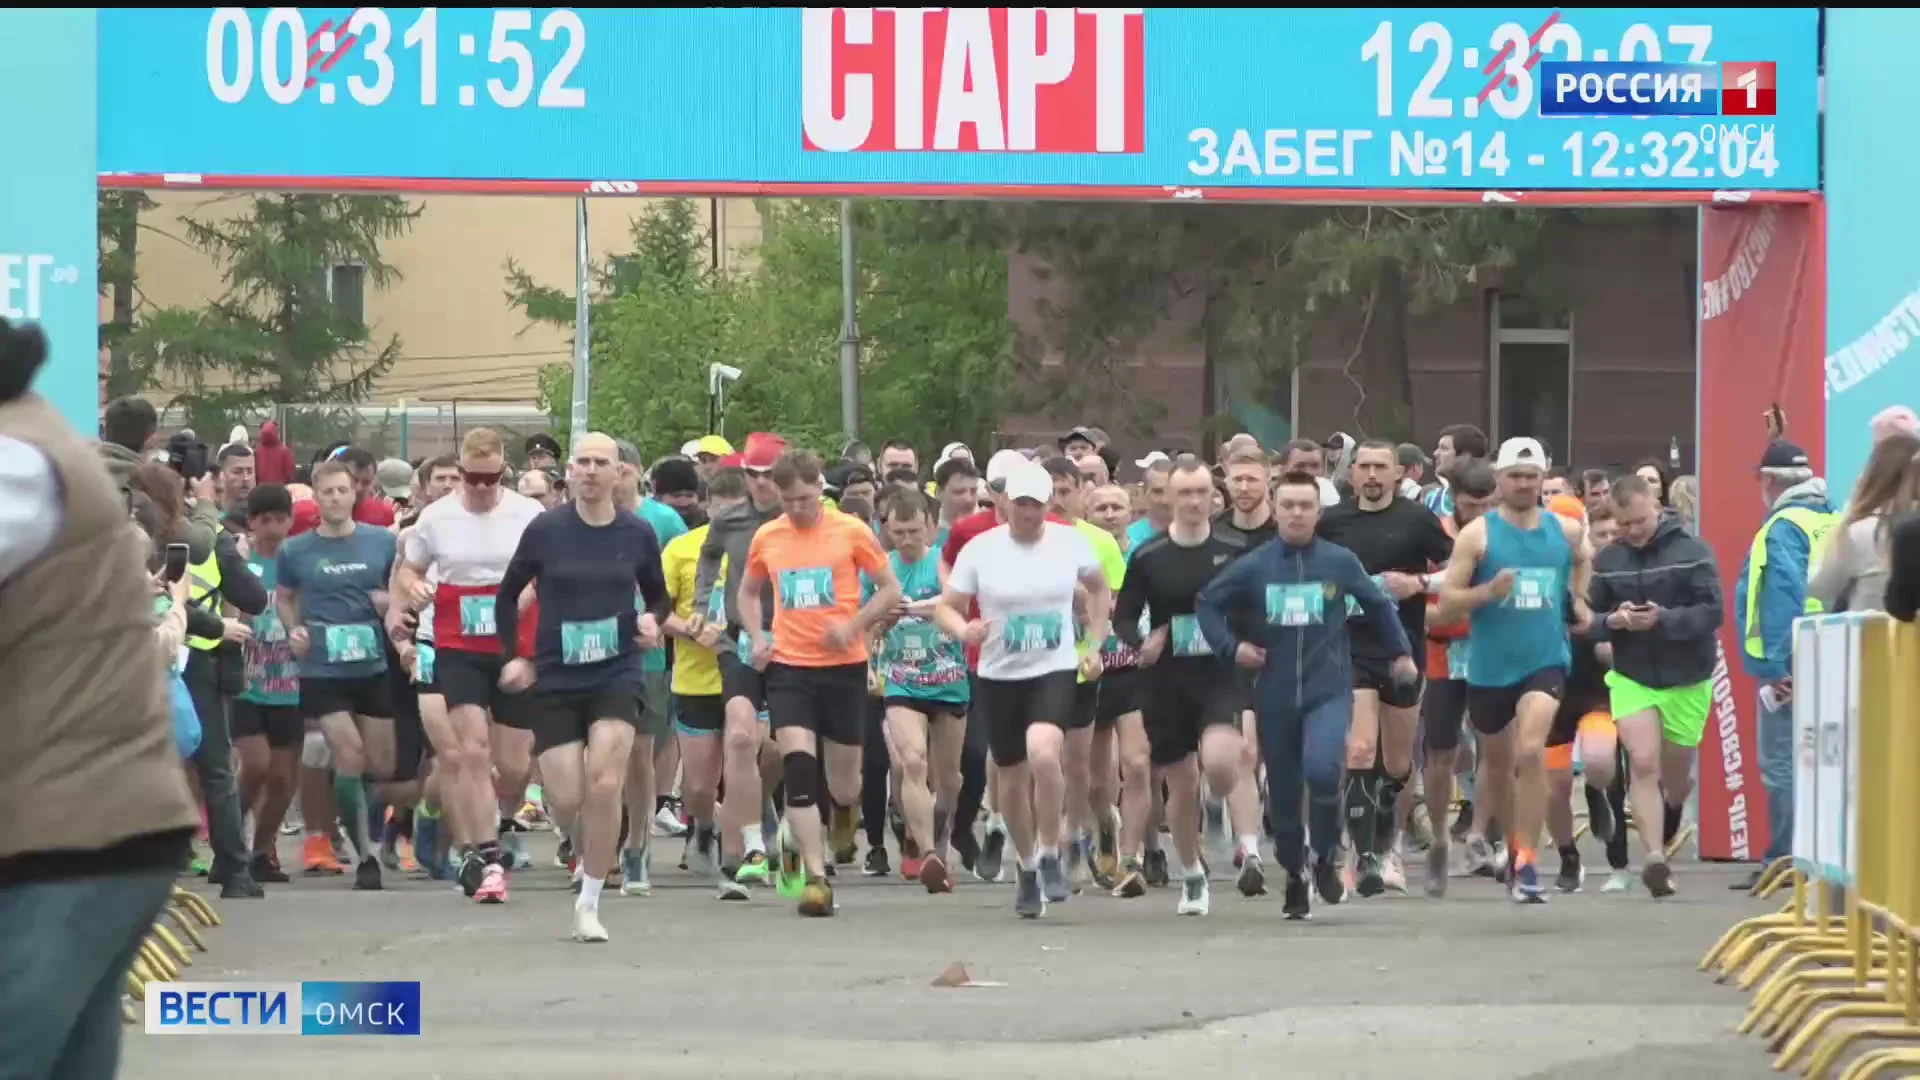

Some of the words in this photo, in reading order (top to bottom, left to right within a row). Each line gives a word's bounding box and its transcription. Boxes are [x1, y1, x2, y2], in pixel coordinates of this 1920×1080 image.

[206, 8, 586, 107] 00:31:52
[802, 8, 1143, 152] СТАРТ
[1188, 128, 1373, 176] ЗАБЕГ
[1390, 130, 1510, 177] №14
[1528, 154, 1544, 165] -
[1562, 131, 1780, 178] 12:32:04
